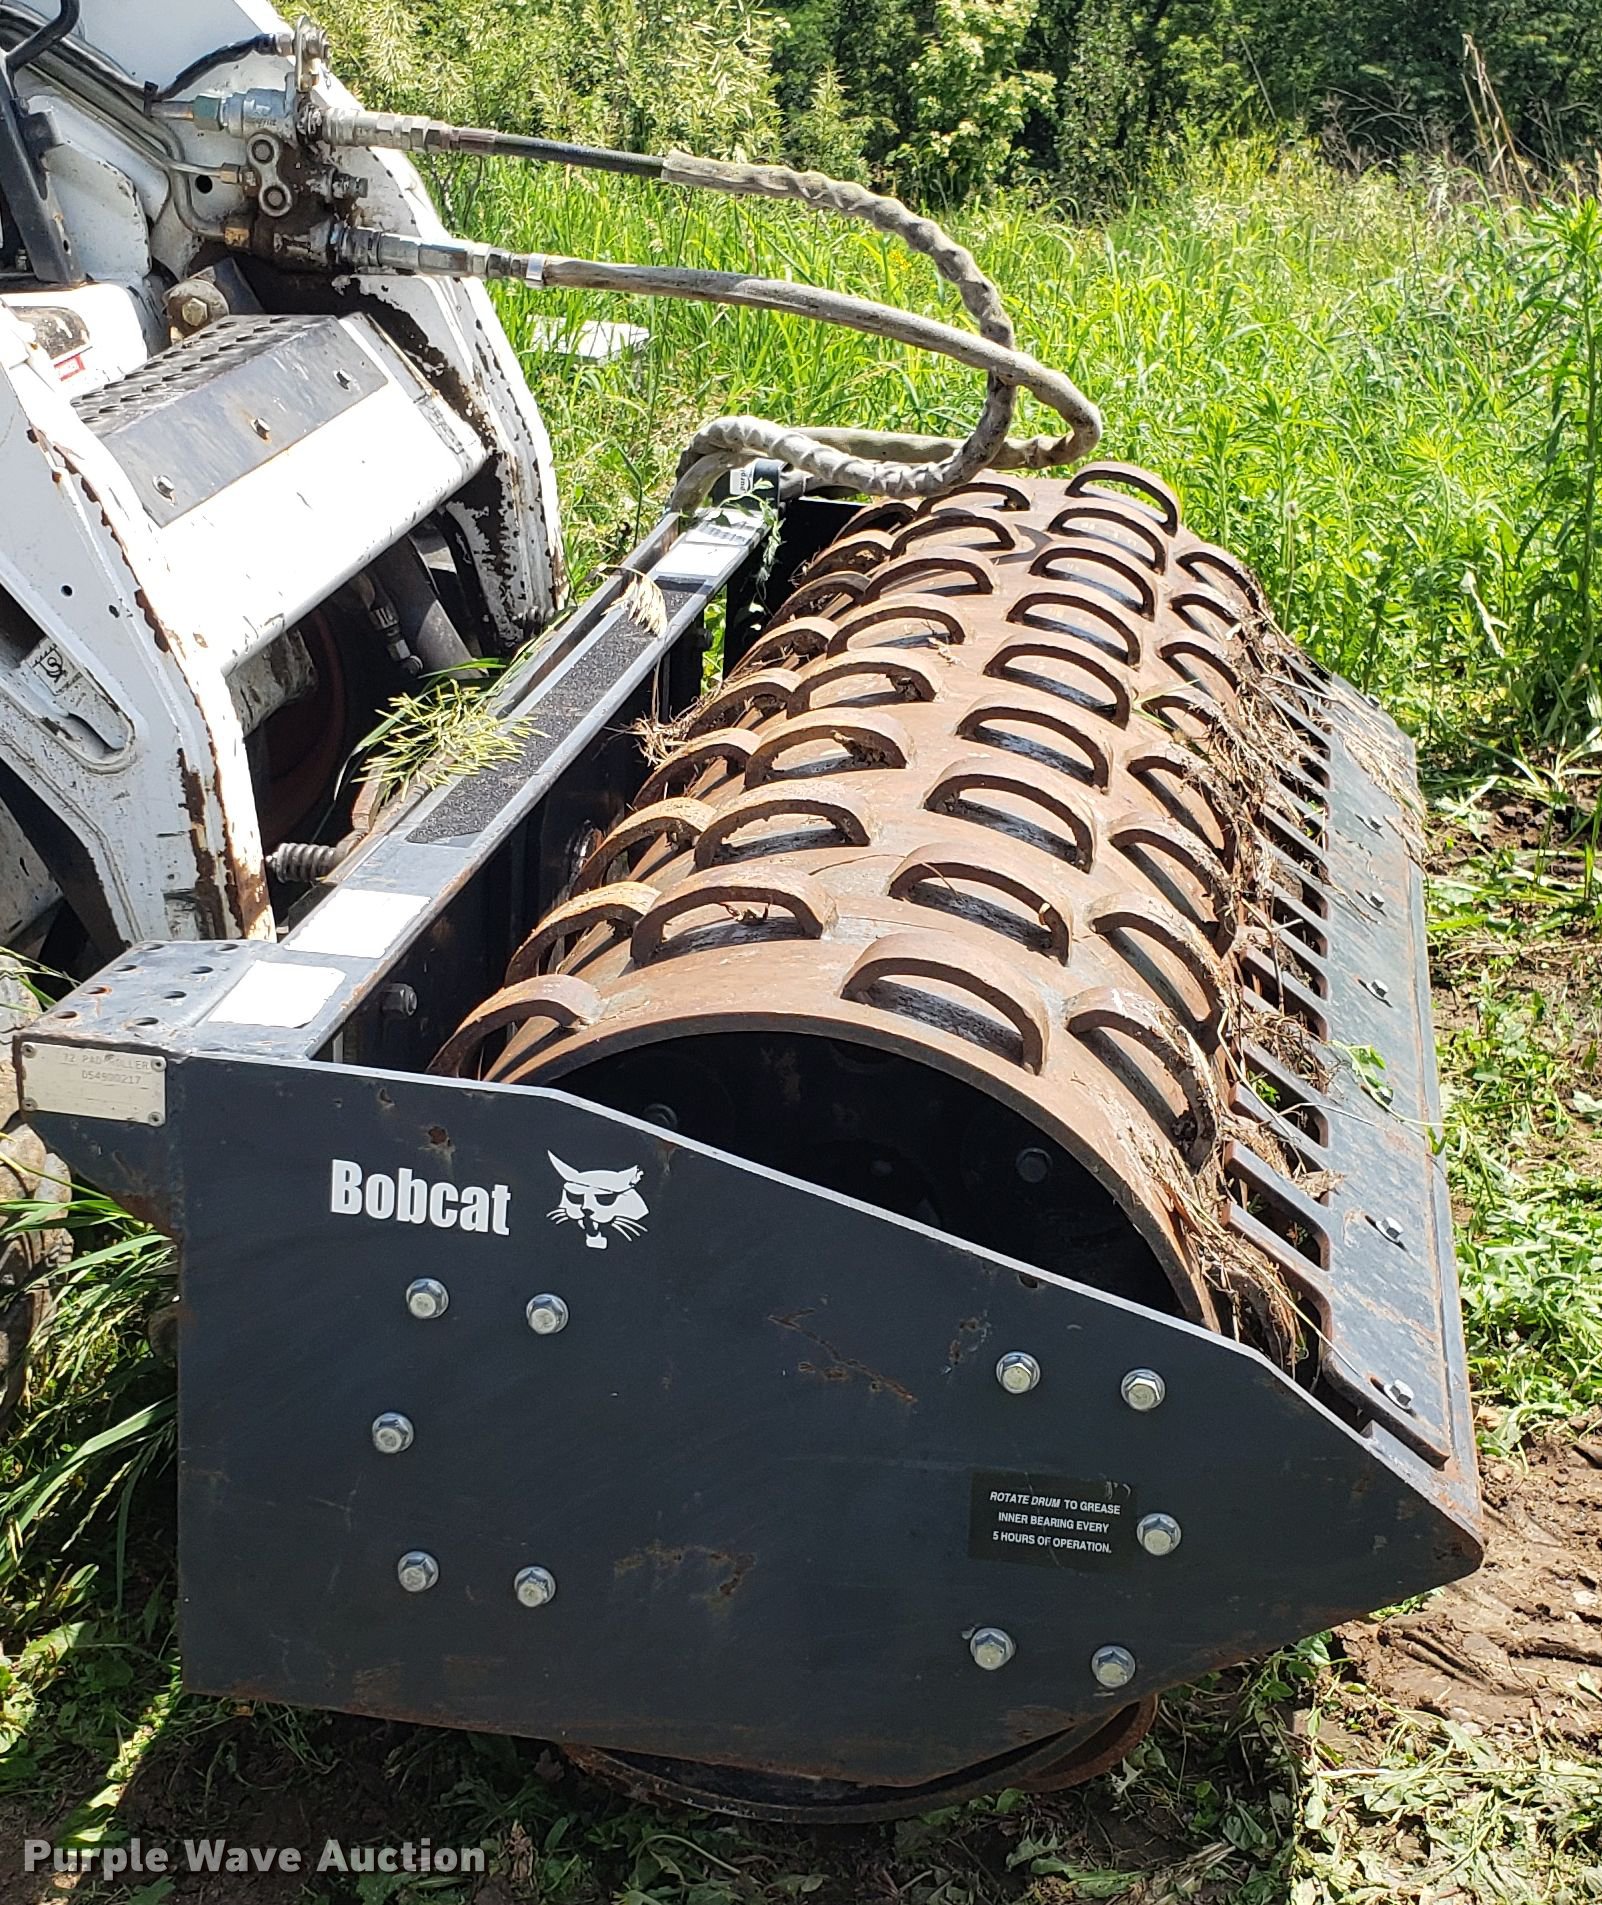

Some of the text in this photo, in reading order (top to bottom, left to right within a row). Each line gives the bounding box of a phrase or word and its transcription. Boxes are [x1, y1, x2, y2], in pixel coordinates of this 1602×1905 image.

[82, 1054, 101, 1065] PAD
[330, 1159, 511, 1236] Bobcat
[989, 1491, 1121, 1515] ROTATE DRUM TO GREASE
[998, 1511, 1110, 1534] INNER BEARING EVERY
[992, 1530, 1113, 1554] 5 HOURS OF OPERATION.
